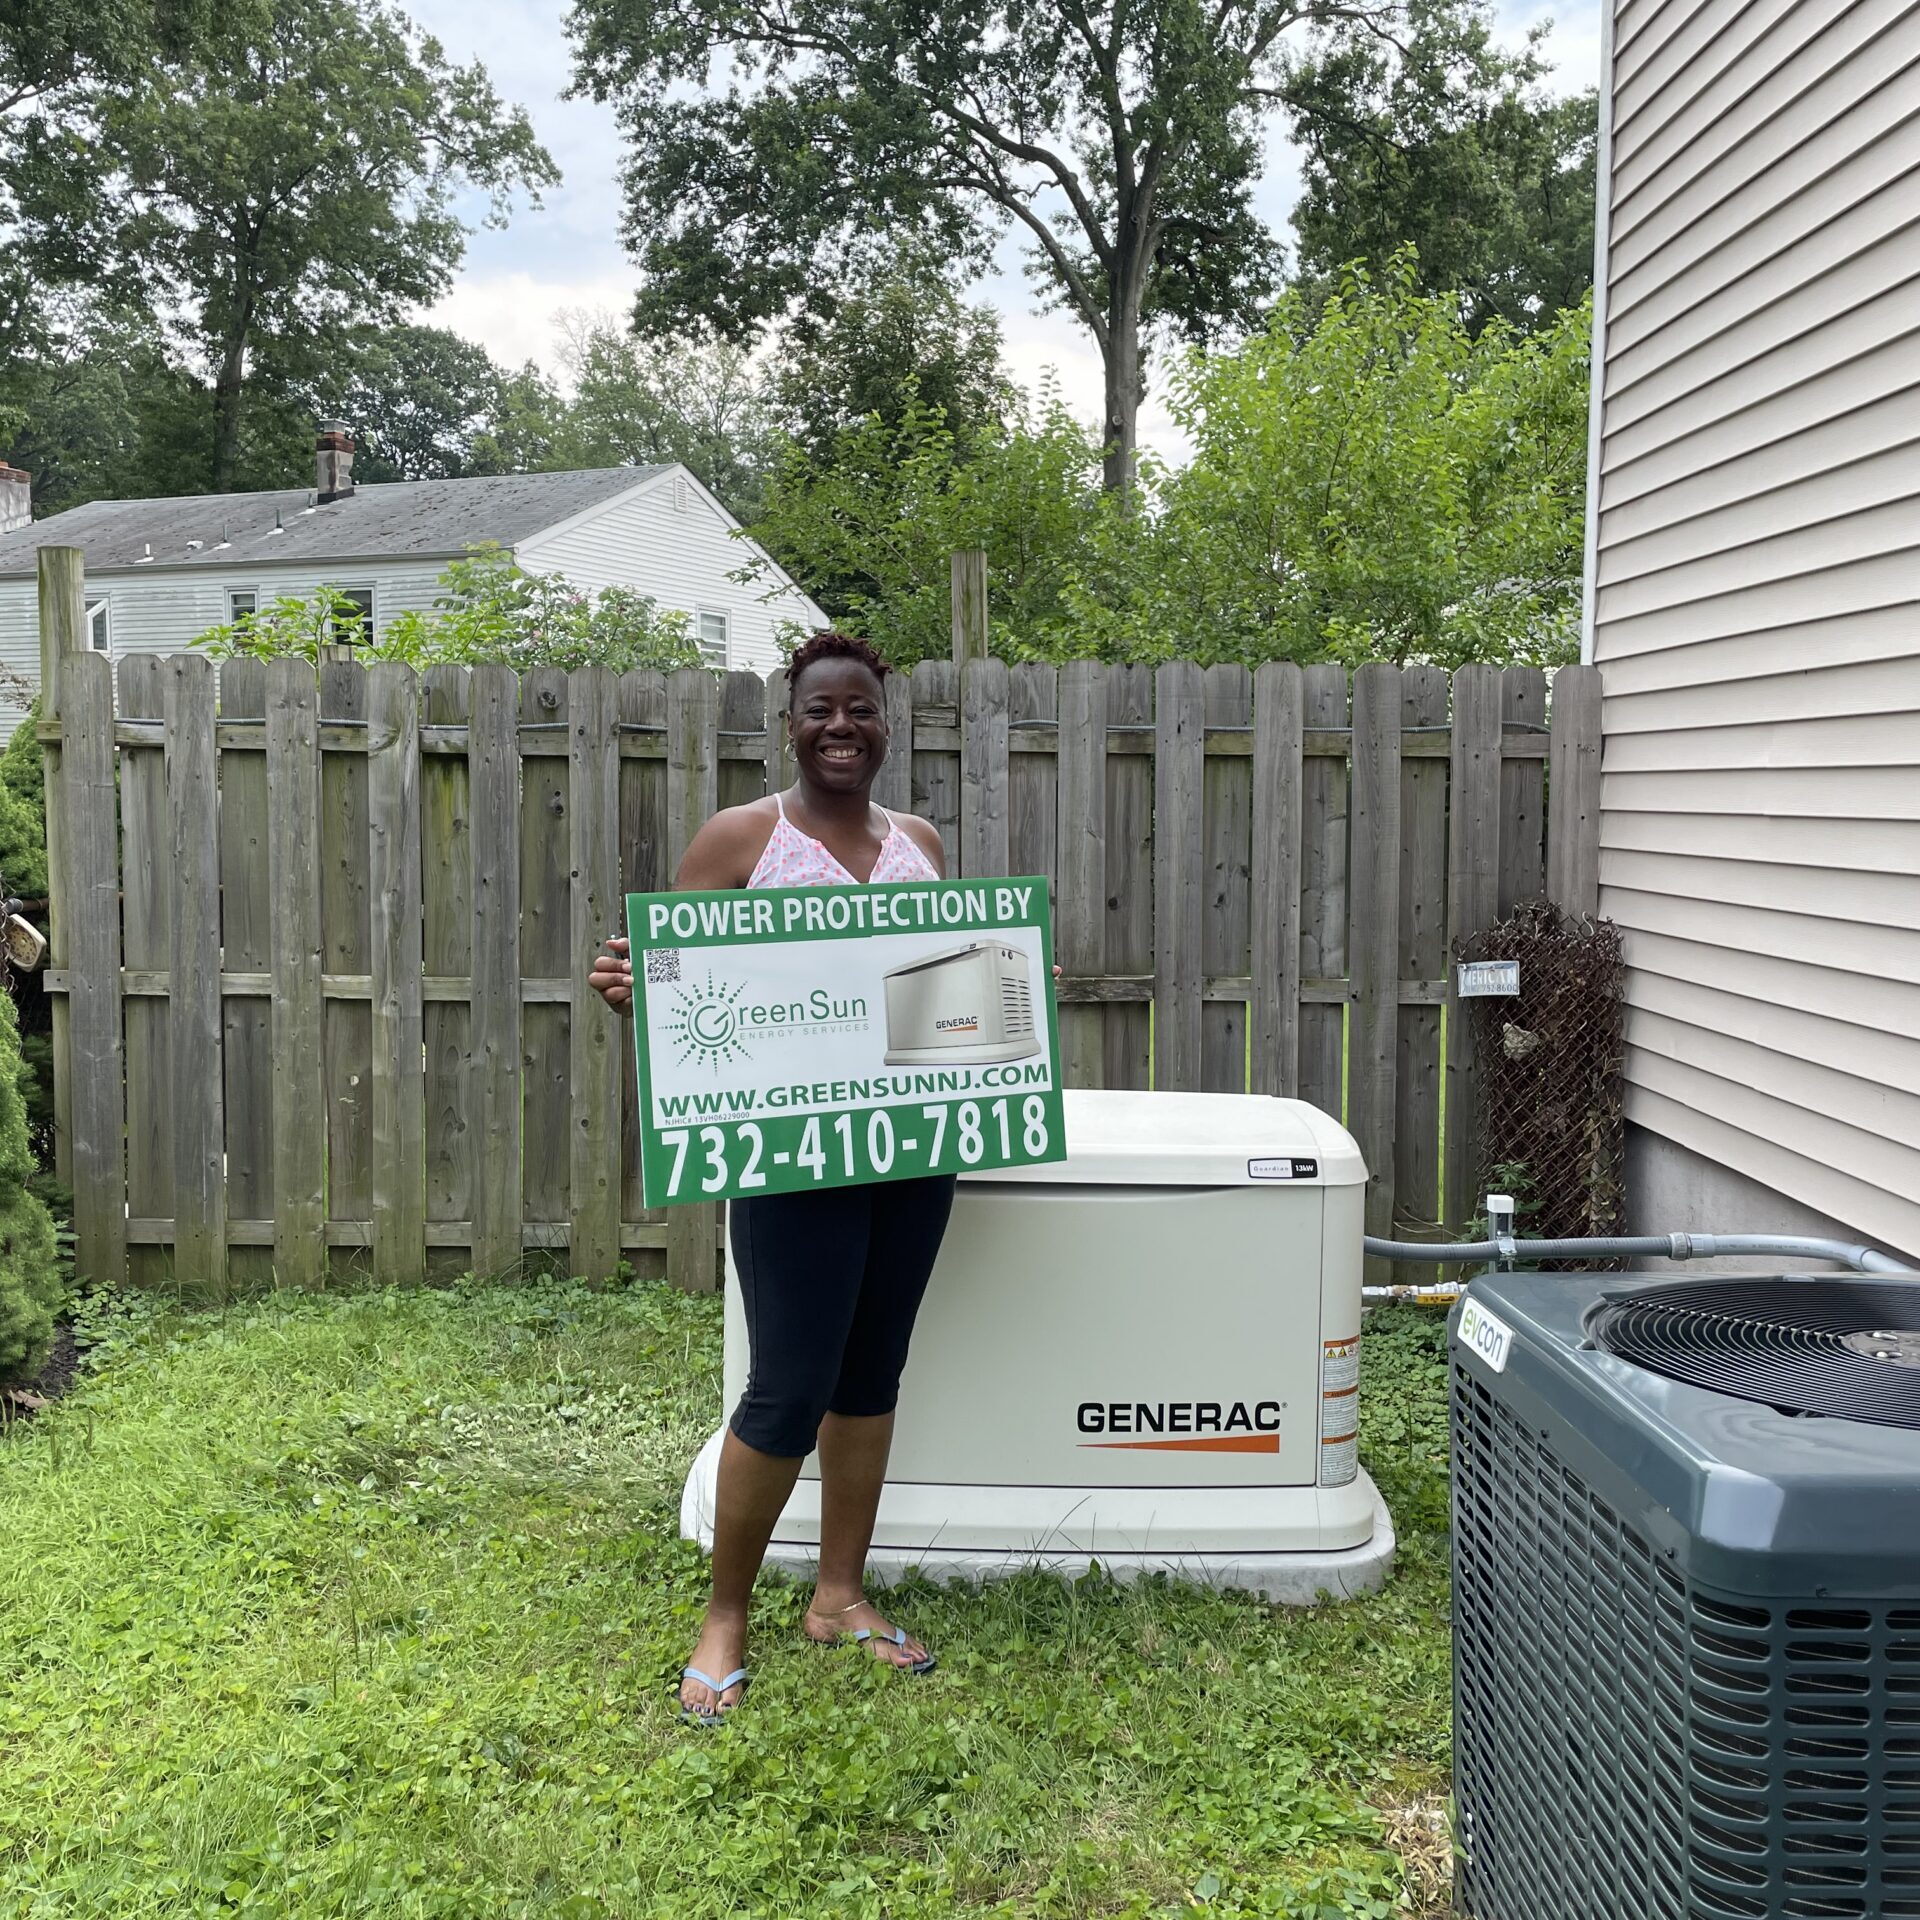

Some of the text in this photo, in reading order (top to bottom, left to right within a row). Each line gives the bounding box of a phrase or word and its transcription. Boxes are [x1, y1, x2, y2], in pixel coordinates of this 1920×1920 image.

[648, 887, 1033, 940] POWER PROTECTION BY
[740, 1023, 870, 1041] ENERGY SERVICES
[936, 1016, 978, 1029] GENERAC
[658, 1063, 1049, 1118] WWW.GREENSUNNJ.COM
[695, 1112, 750, 1124] 13VH06229000
[661, 1094, 1049, 1197] 732-410-7818
[1463, 1308, 1503, 1362] evcon
[1077, 1401, 1280, 1433] GENERAC
